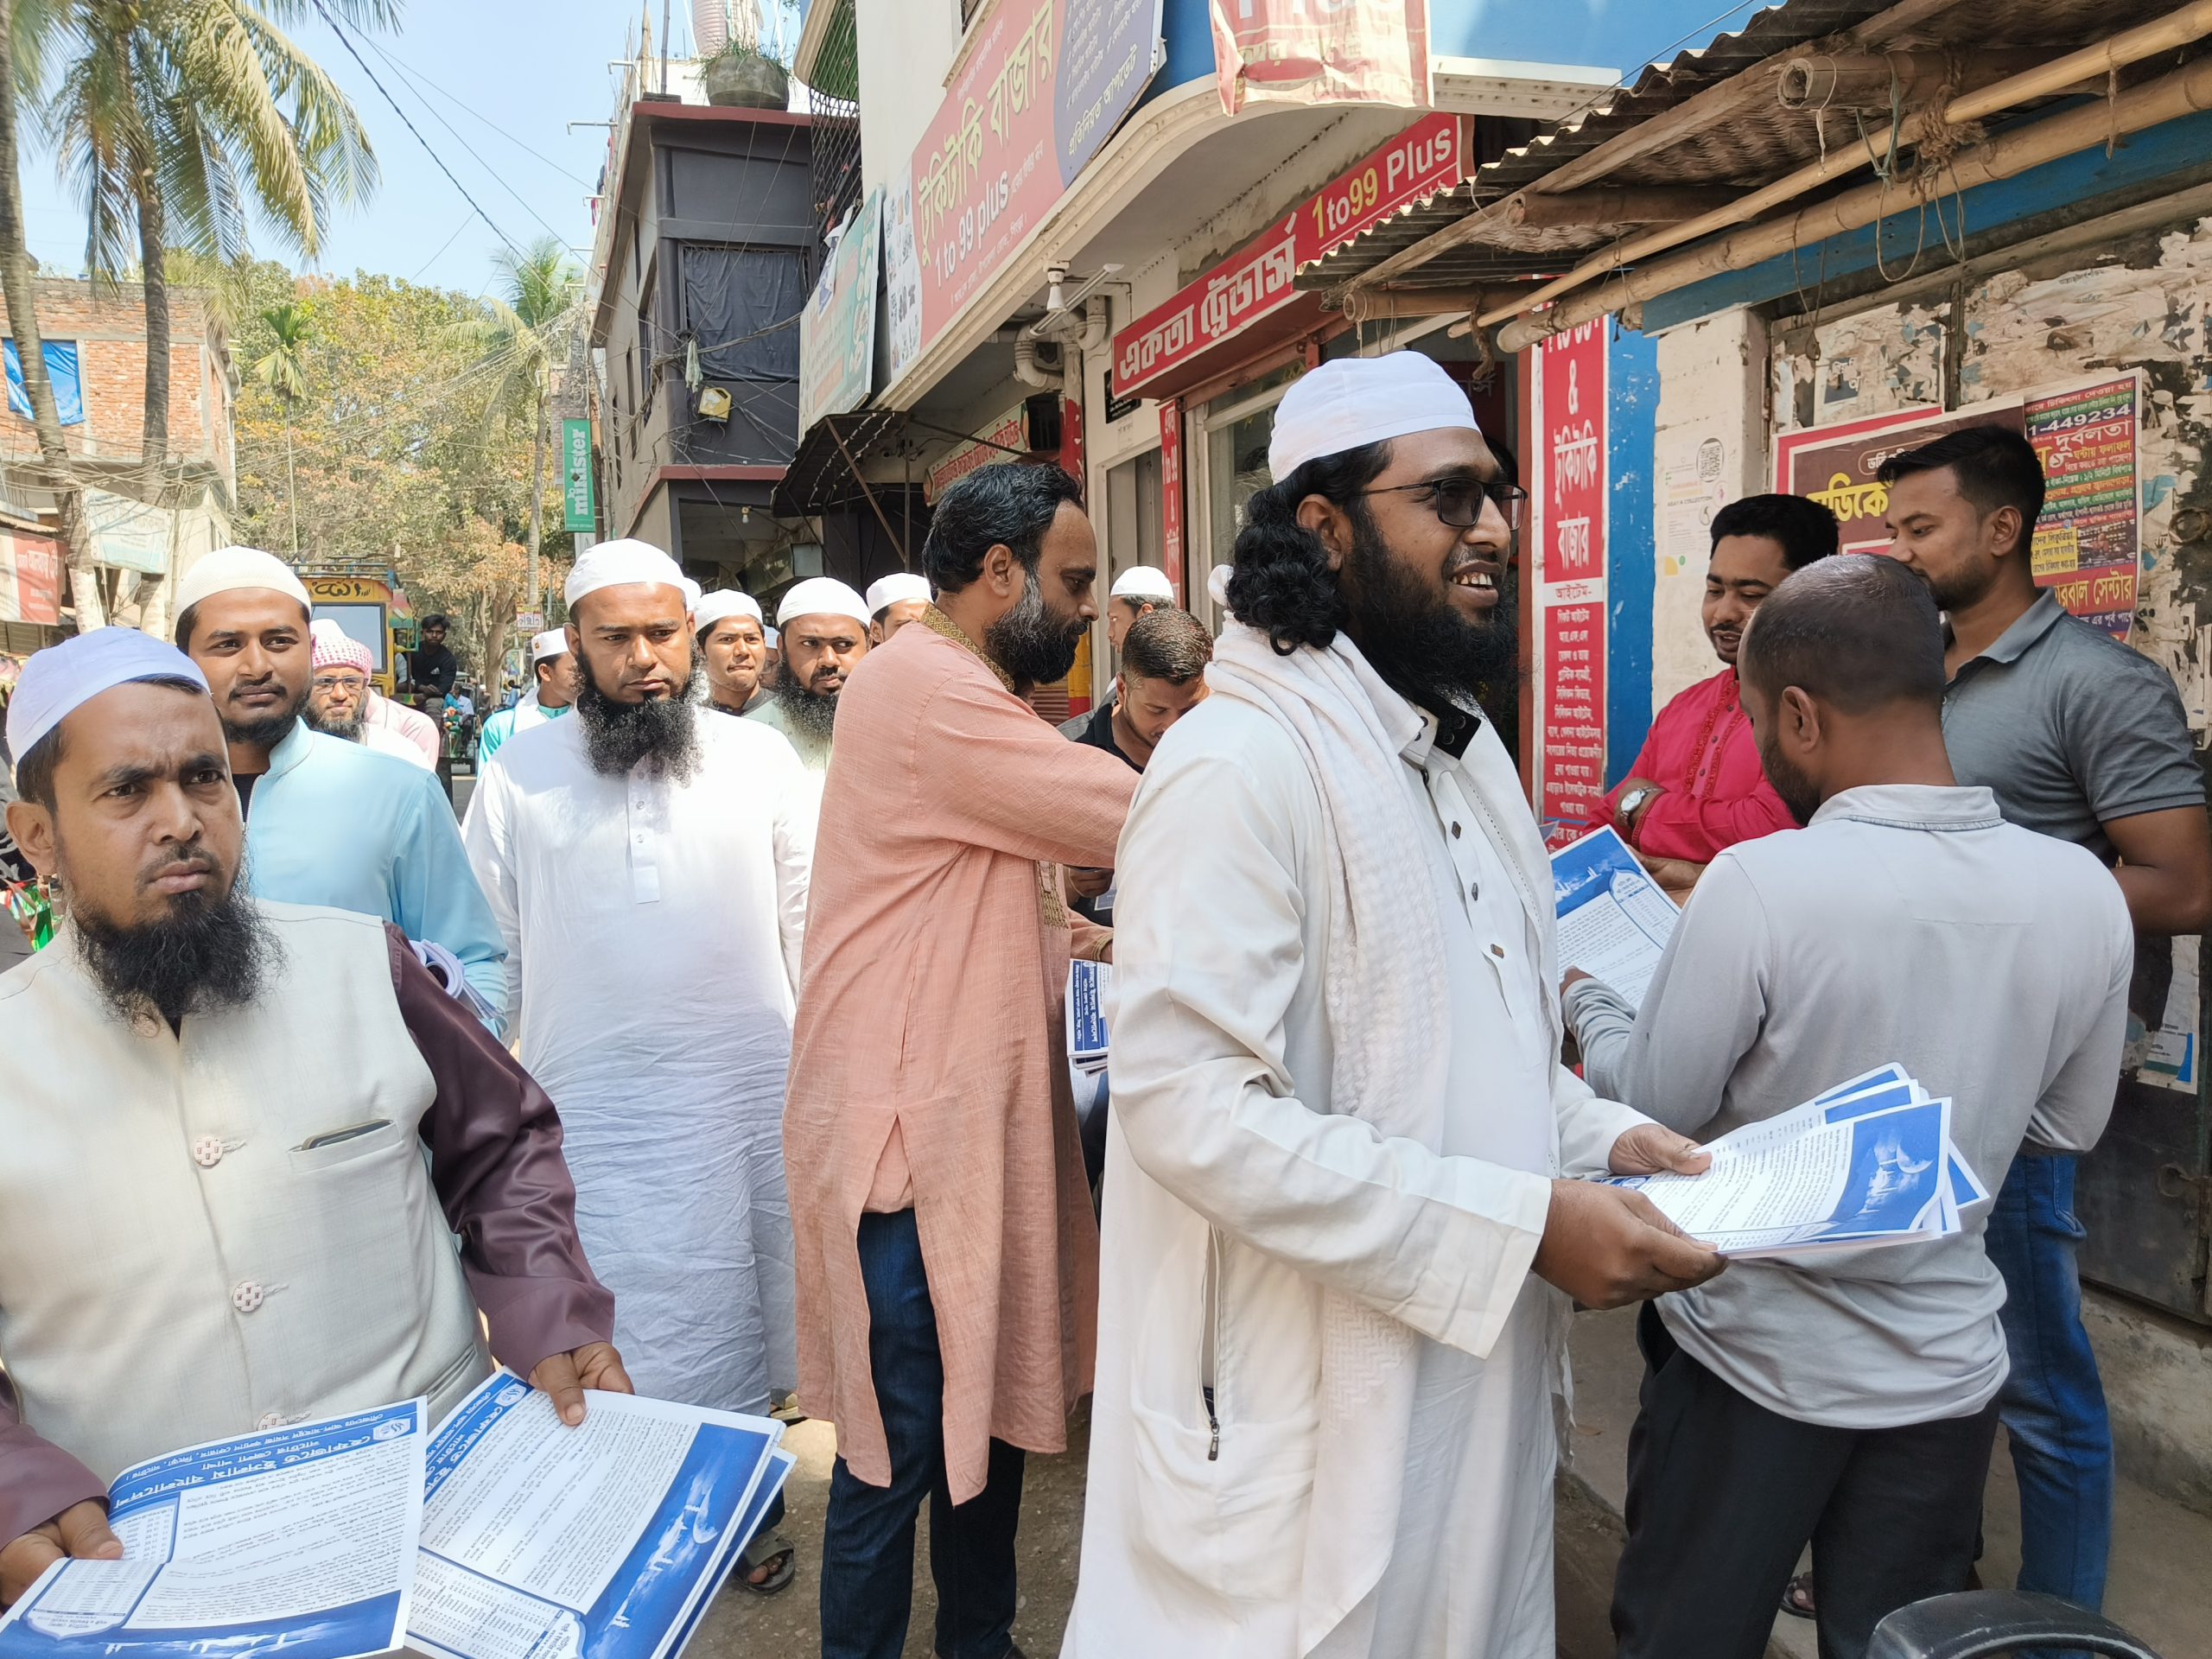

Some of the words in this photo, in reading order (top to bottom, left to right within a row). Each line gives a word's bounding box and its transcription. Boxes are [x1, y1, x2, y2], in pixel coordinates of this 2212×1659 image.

[1068, 99, 1102, 156] প্রতিনিয়ত
[1103, 43, 1138, 105] আপডেট
[918, 97, 985, 267] টুকিটাকি
[987, 0, 1055, 149] বাজার
[1313, 168, 1379, 238] 1to99
[1386, 127, 1452, 194] Plus
[935, 247, 943, 289] 1
[944, 240, 957, 279] to
[958, 206, 974, 261] 99
[977, 170, 1009, 250] plus
[1120, 304, 1196, 381] একতা
[1200, 211, 1296, 338] ট্রেডার্স
[2085, 385, 2116, 399] দেওয়া
[2054, 419, 2133, 452] দুর্বলতা
[2099, 440, 2132, 455] ফলাফল
[568, 429, 588, 516] minister
[1554, 419, 1598, 512] টুকিটাকি
[1556, 511, 1591, 569] বাজার
[2094, 568, 2133, 605] সেন্টার
[238, 1450, 274, 1464] জেলা
[277, 1440, 321, 1454] নাটোর
[284, 1435, 371, 1464] হেফাজতে
[200, 1459, 233, 1471] শাখা
[211, 1459, 278, 1482] ইসলাম
[114, 1476, 206, 1510] বাংলাদেশ
